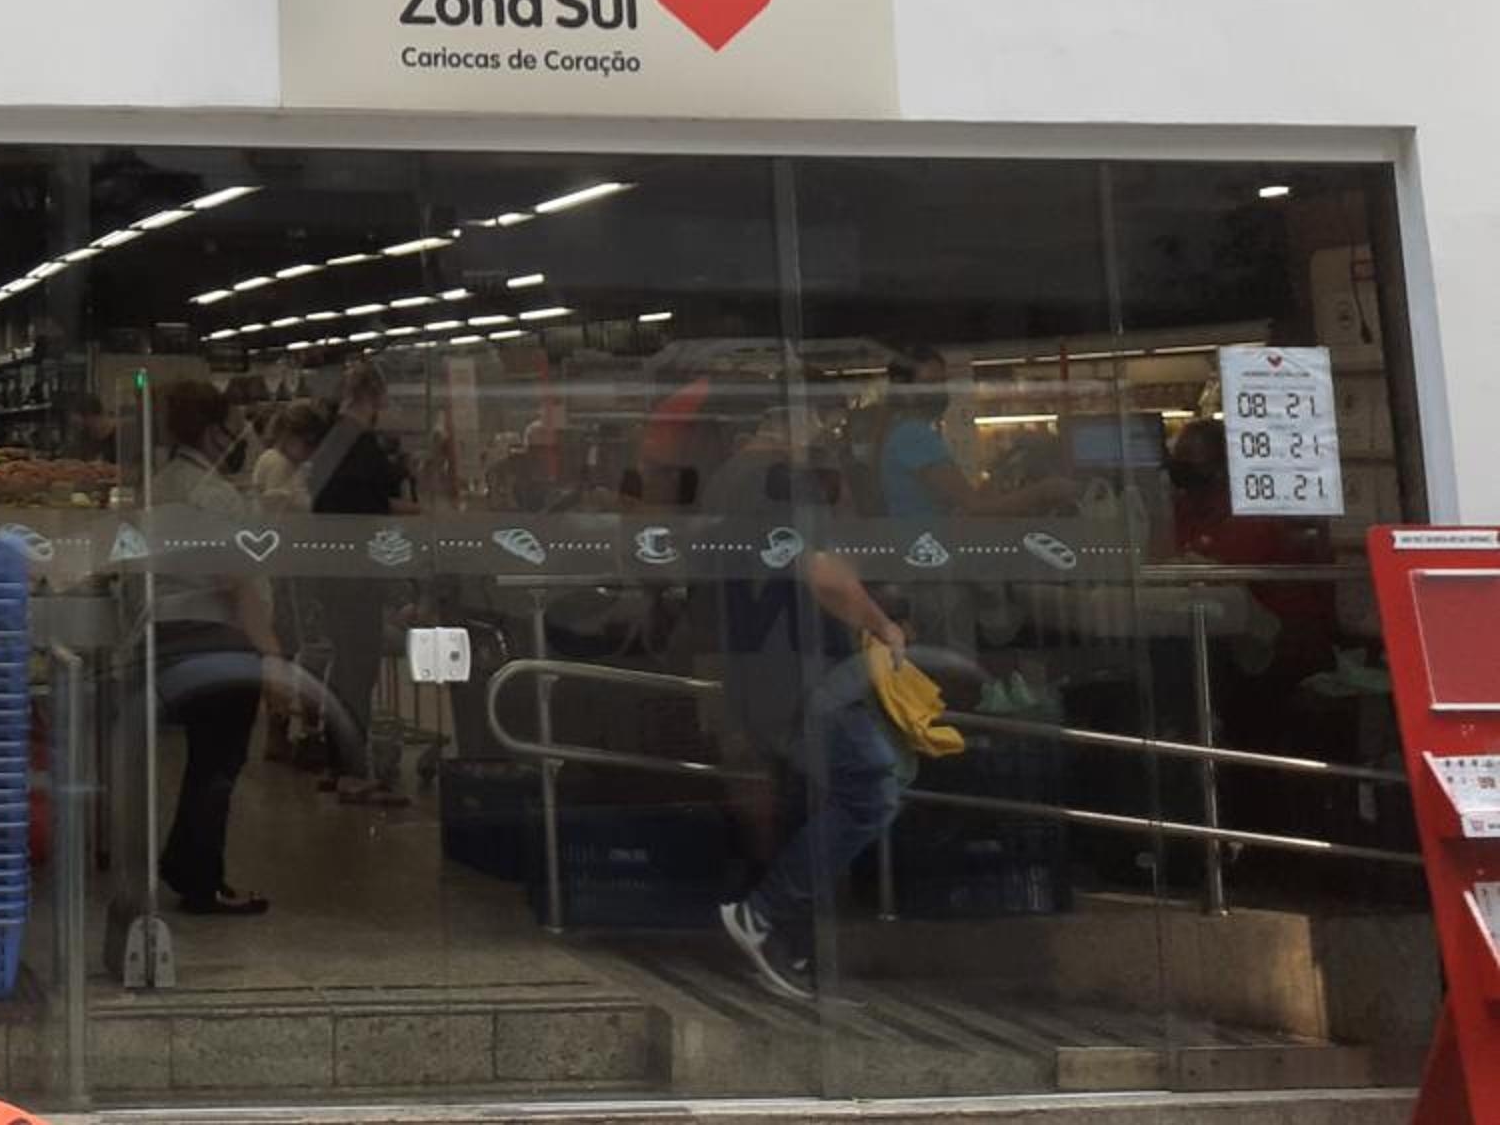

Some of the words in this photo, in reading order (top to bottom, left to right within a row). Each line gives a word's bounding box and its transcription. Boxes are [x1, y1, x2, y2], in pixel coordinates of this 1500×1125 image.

[400, 46, 501, 70] Cariocas
[507, 48, 538, 71] de
[544, 49, 642, 77] Coração
